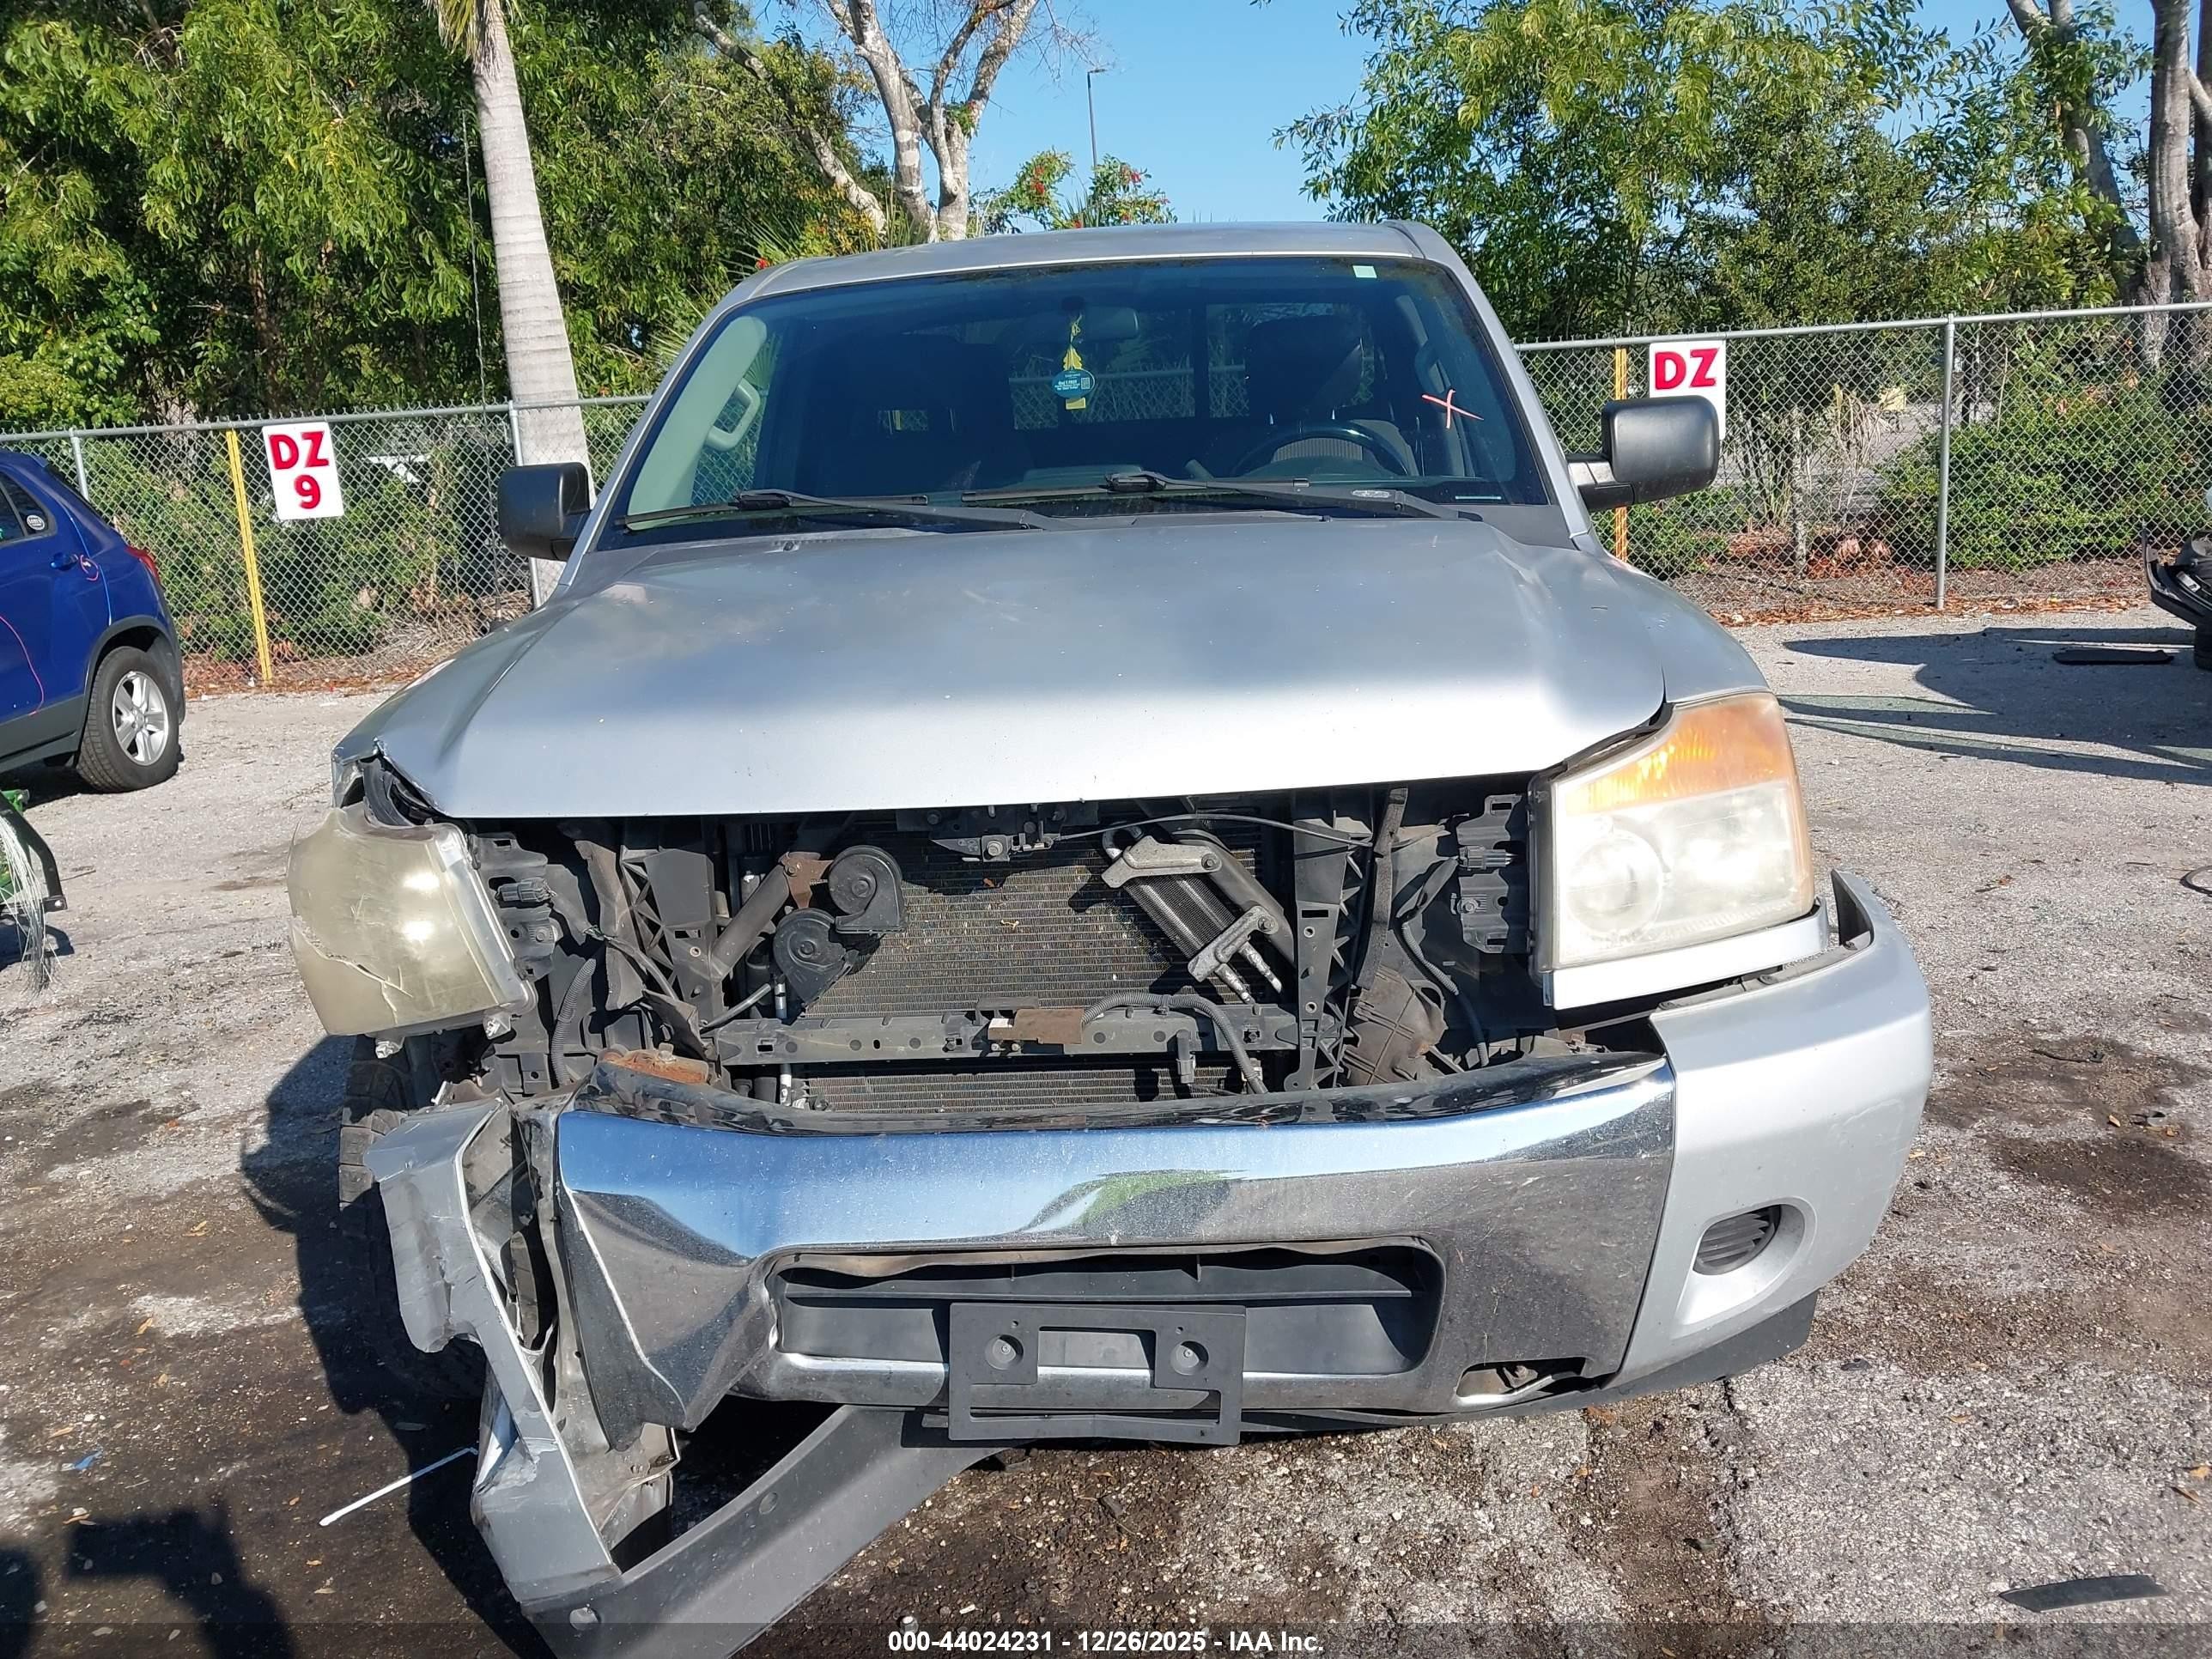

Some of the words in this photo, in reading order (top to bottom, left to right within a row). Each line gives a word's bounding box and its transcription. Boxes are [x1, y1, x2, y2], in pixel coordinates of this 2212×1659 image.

[1655, 347, 1720, 391] DZ
[269, 431, 330, 471] DZ
[293, 474, 321, 510] 9
